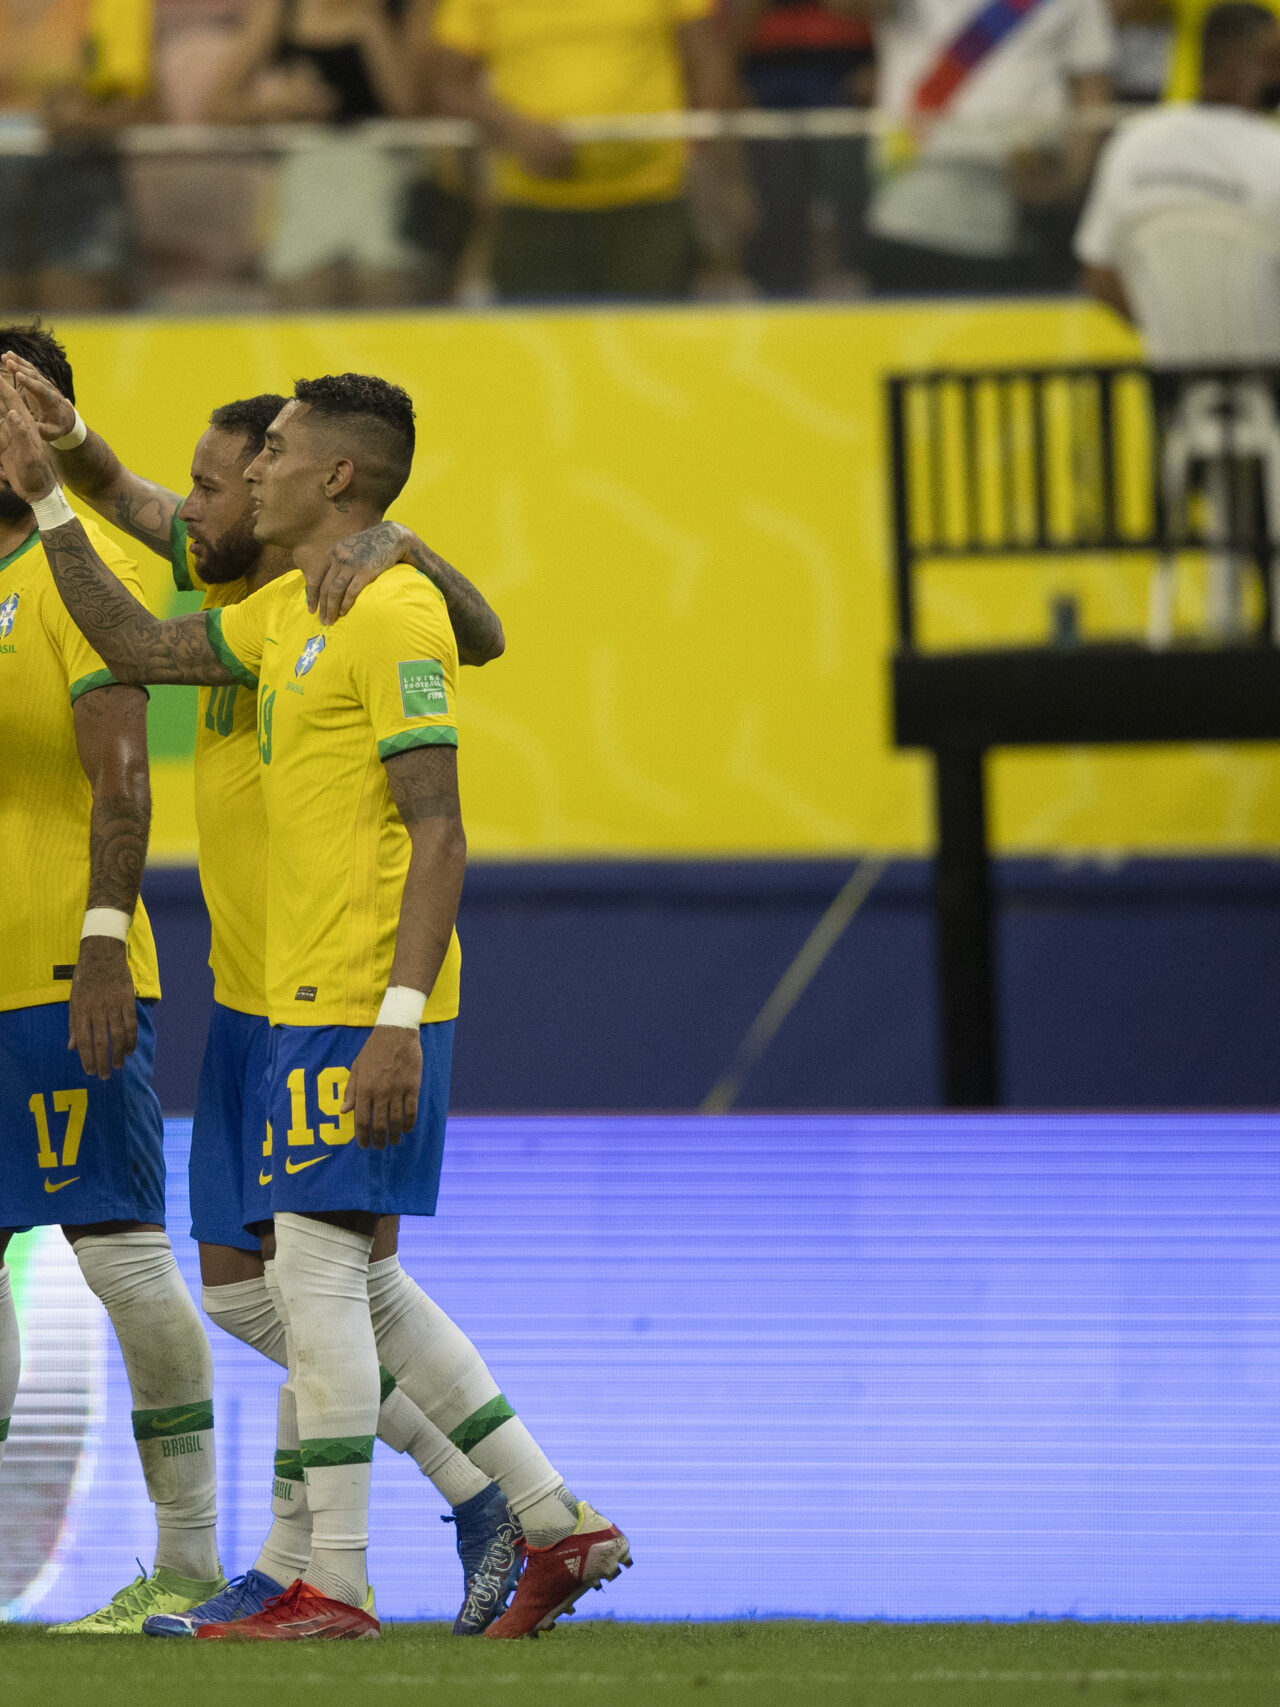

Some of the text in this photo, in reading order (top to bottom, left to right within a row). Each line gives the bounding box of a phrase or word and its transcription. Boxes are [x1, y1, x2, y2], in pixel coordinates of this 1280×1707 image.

[403, 674, 440, 683] LIVING
[404, 680, 441, 690] FOOTBALL
[427, 691, 443, 700] FIFA
[286, 1066, 356, 1146] 19
[28, 1088, 89, 1169] 17
[161, 1434, 204, 1458] BRASIL
